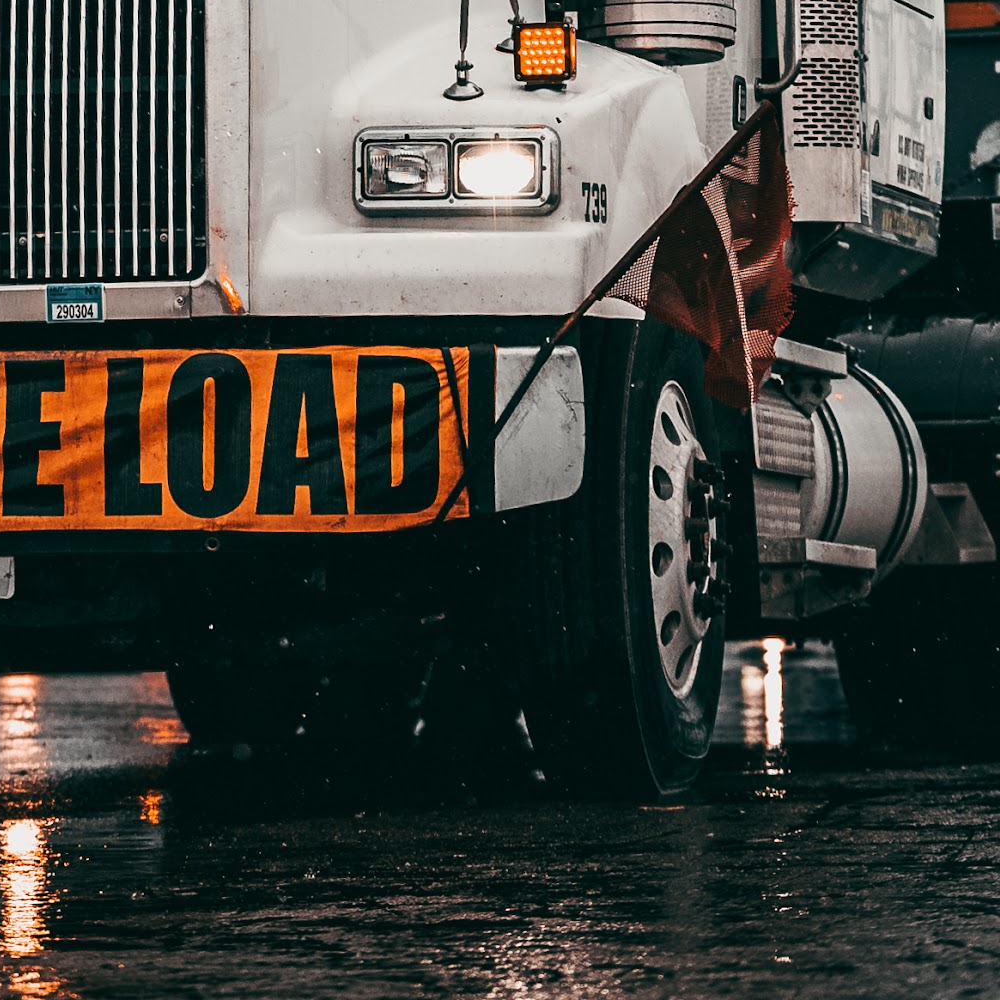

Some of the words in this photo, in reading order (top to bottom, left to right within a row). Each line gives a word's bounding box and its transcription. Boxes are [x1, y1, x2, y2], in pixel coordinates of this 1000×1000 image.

[581, 182, 607, 224] 739
[56, 304, 93, 319] 290304
[103, 353, 441, 518] LOAD
